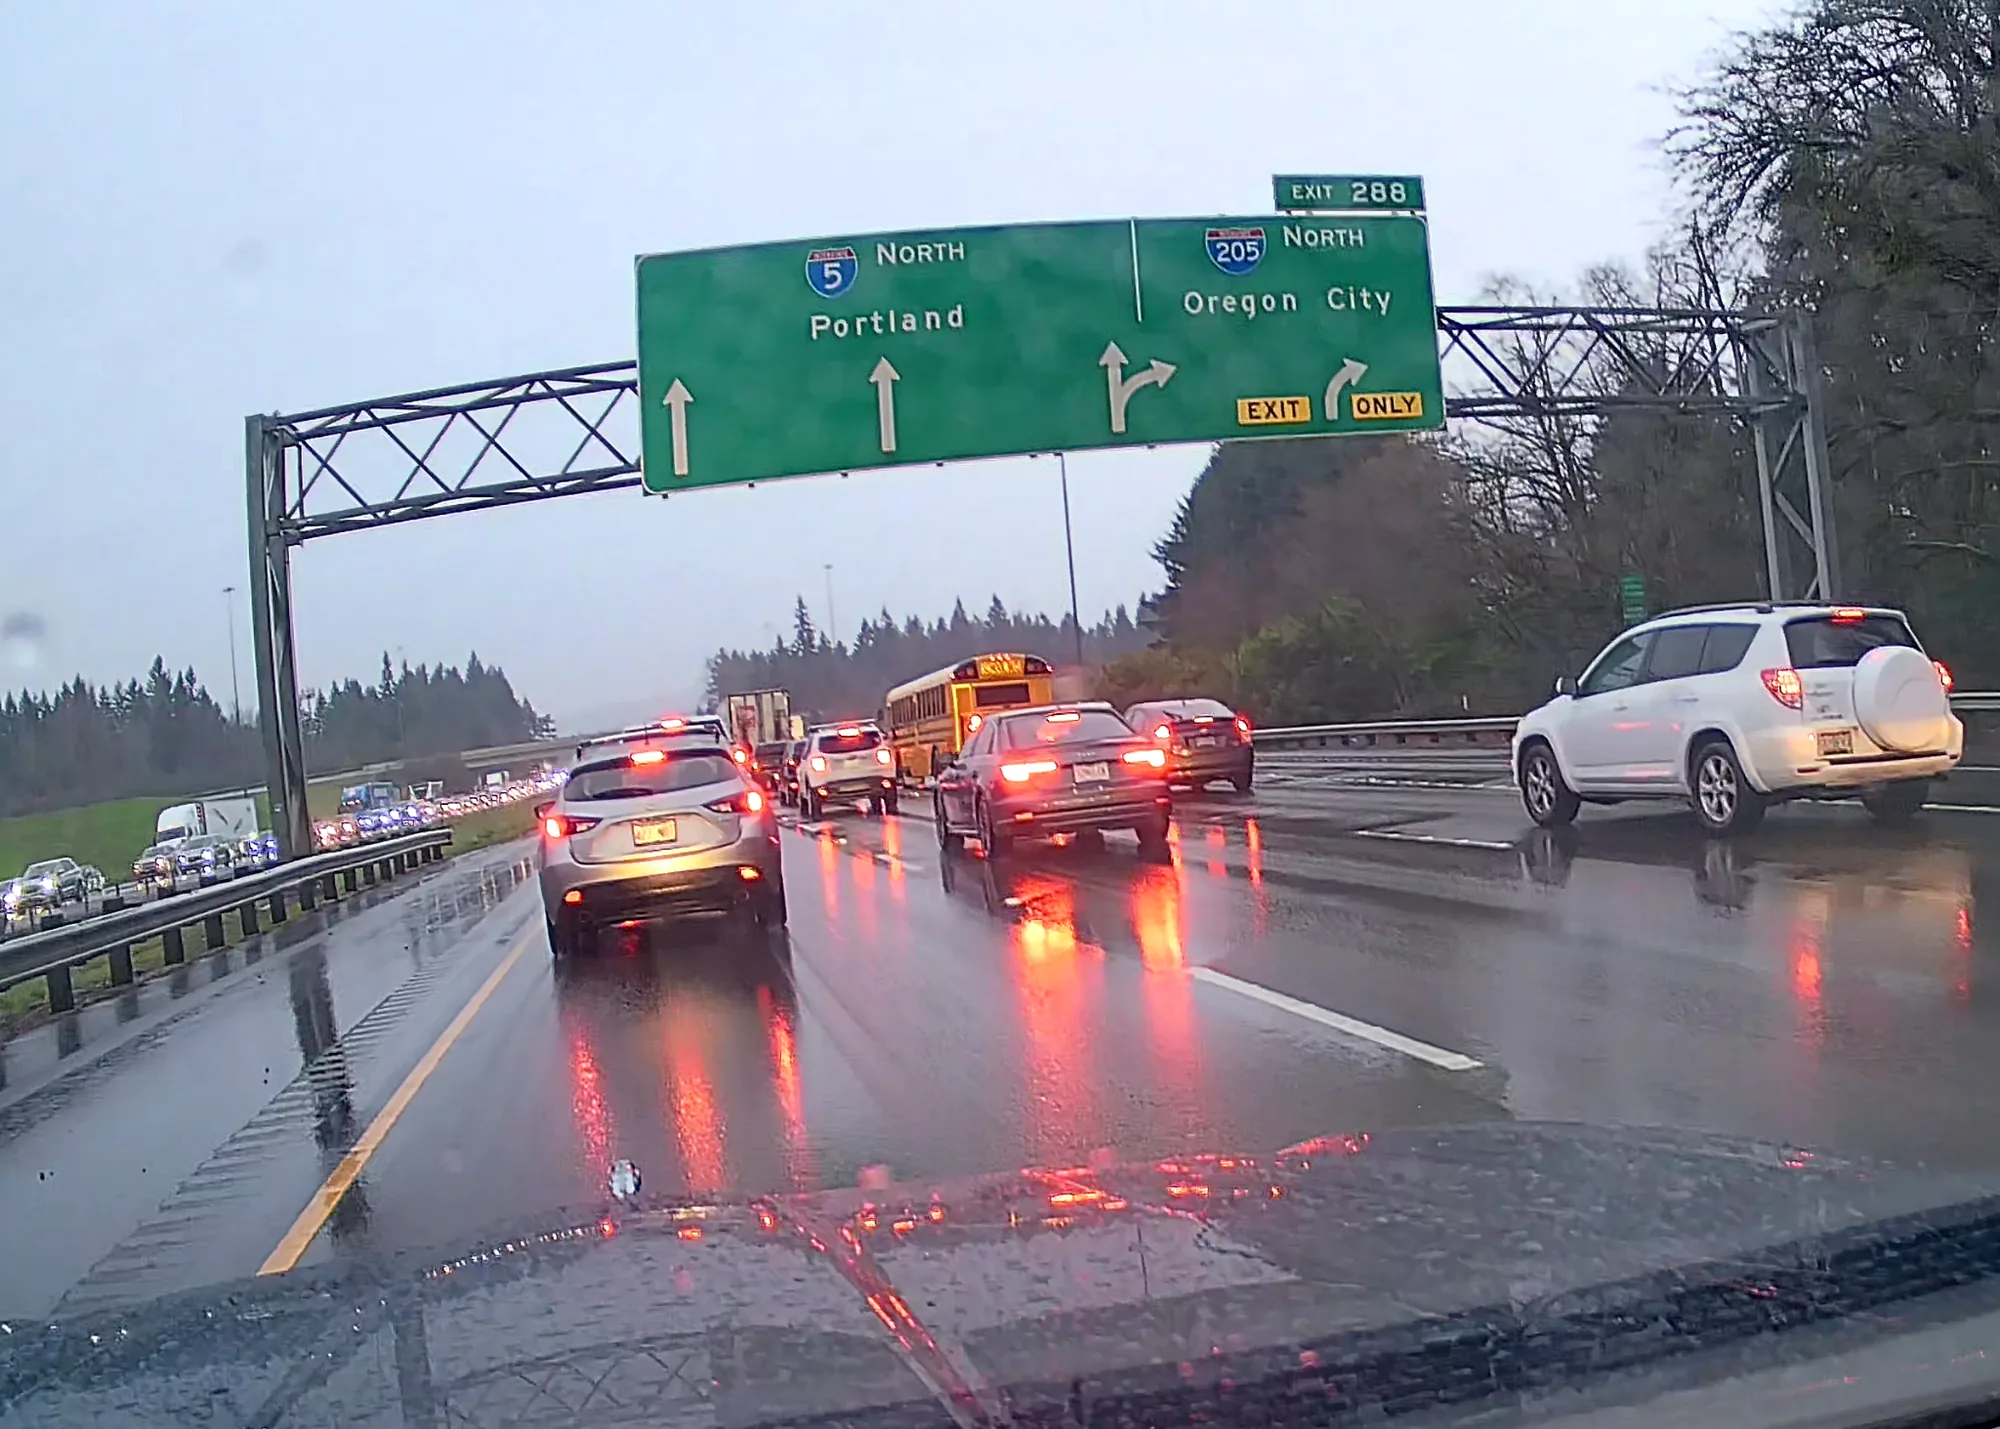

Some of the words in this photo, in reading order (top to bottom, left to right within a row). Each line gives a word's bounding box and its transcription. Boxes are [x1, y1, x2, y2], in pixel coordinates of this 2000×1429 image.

[1291, 184, 1333, 200] EXIT
[1351, 182, 1406, 204] 288
[1283, 225, 1365, 247] NORTH
[876, 242, 965, 266] NORTH
[1216, 241, 1260, 263] 205
[823, 262, 843, 290] 5
[1184, 291, 1298, 320] Oregon
[1327, 286, 1392, 317] City
[810, 304, 964, 341] Portland
[1247, 400, 1300, 420] EXIT
[1356, 395, 1416, 415] ONLY
